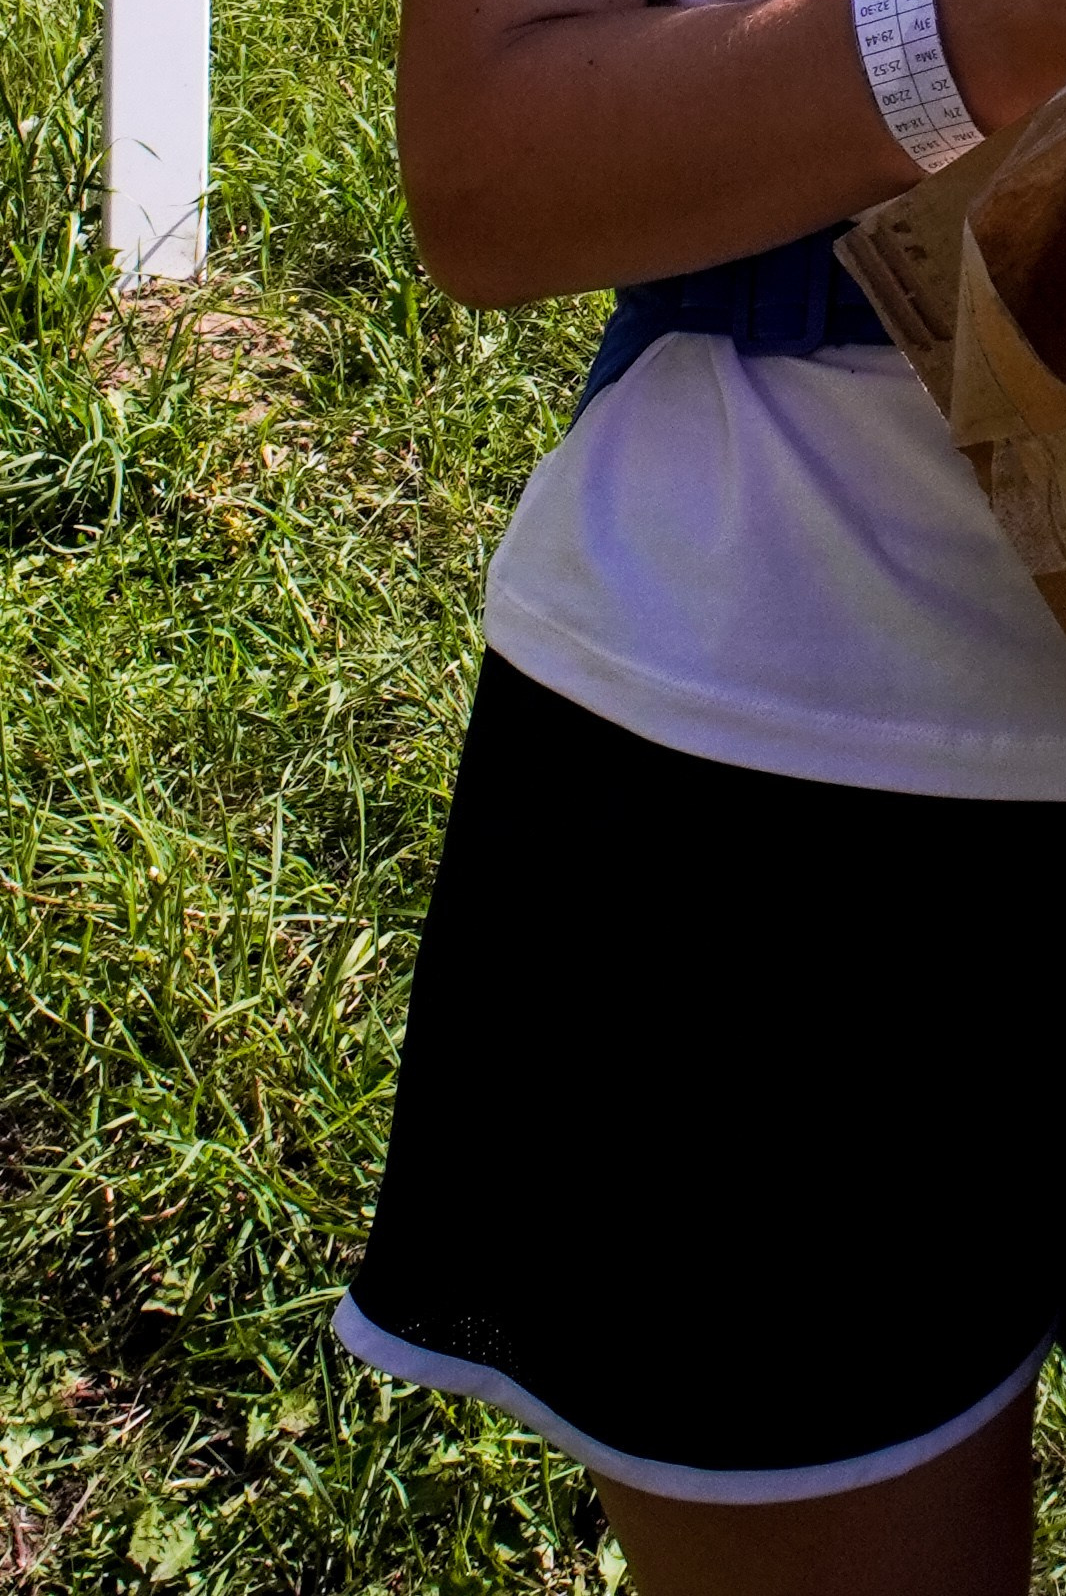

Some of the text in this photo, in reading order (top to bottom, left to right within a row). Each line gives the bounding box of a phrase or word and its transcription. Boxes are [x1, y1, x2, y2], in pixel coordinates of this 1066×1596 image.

[860, 0, 890, 17] 32:30
[865, 29, 894, 47] 29:44
[872, 60, 901, 77] 25:52
[882, 89, 912, 106] 22:00
